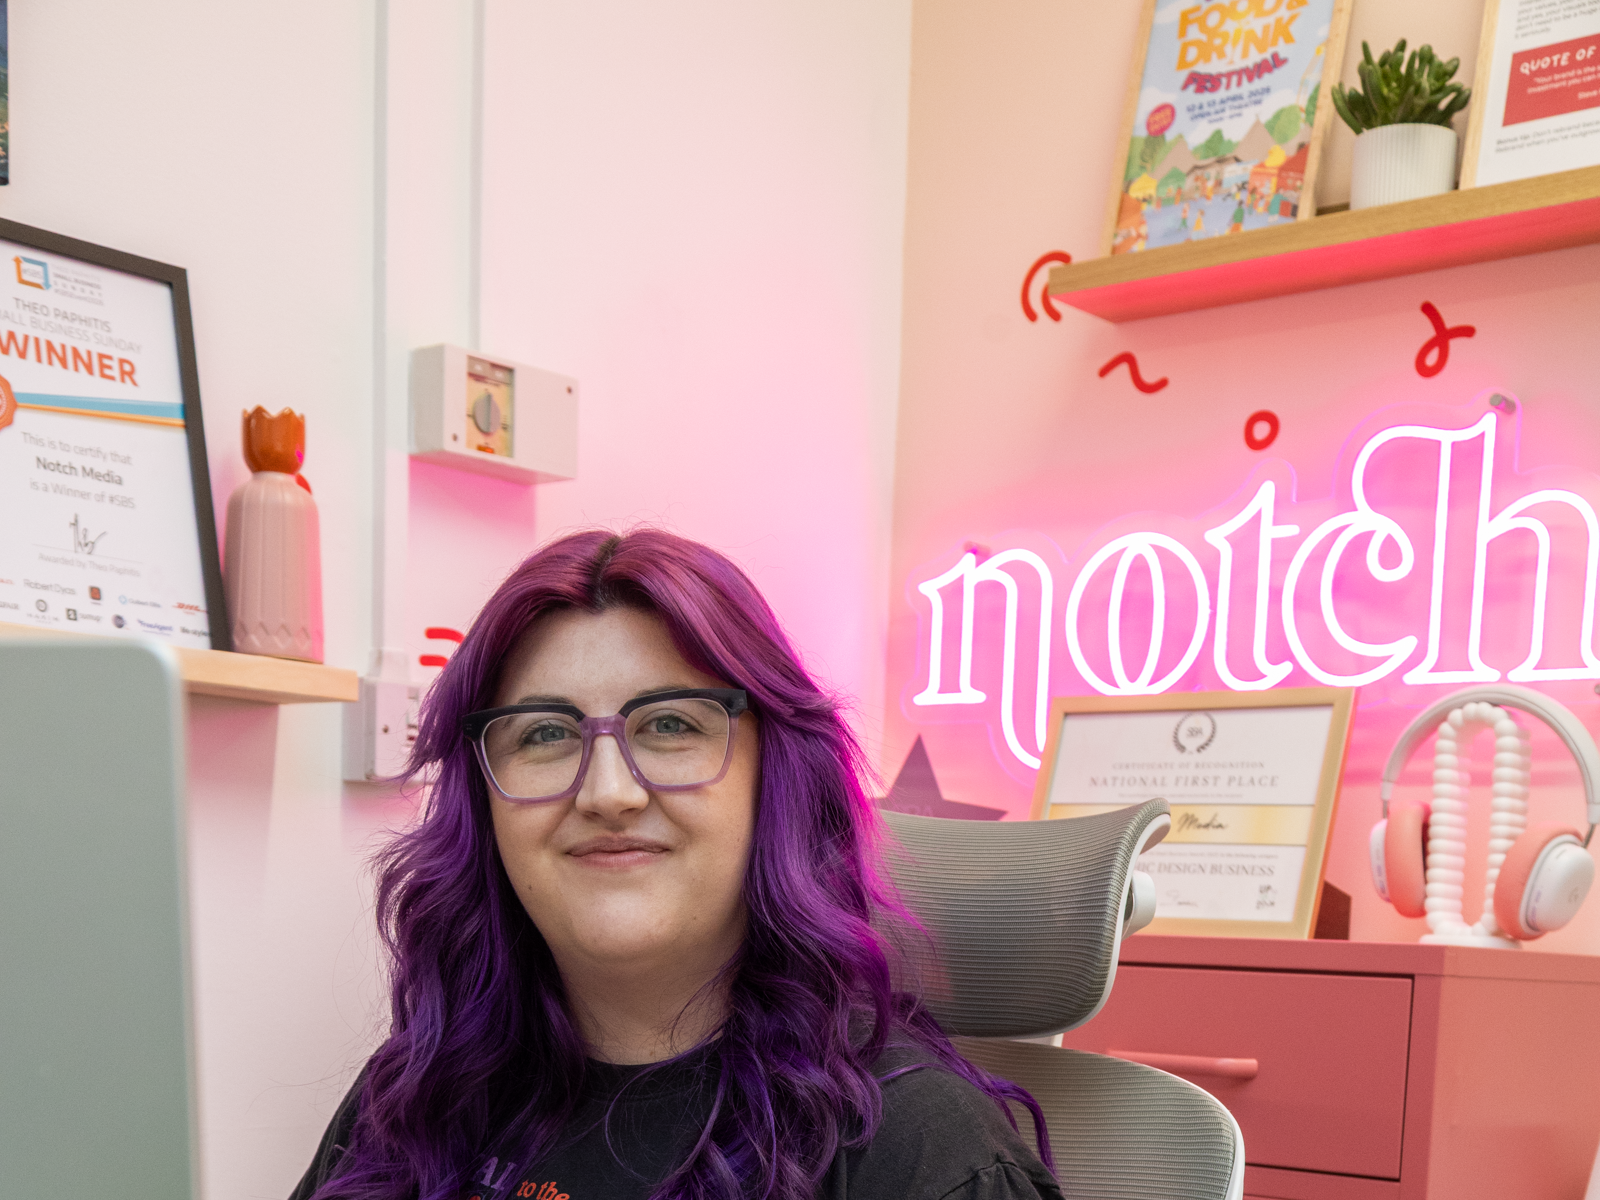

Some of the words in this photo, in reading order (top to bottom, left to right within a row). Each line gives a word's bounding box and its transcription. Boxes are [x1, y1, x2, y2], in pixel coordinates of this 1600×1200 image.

[1175, 13, 1301, 71] DRINK
[1181, 51, 1289, 94] FESTIVAL
[1519, 52, 1571, 76] QUOTE
[1575, 45, 1597, 61] OF
[0, 309, 27, 327] ALL
[30, 316, 90, 342] BUSINESS
[93, 331, 142, 353] SUNDAY
[13, 297, 49, 317] THEO
[53, 308, 112, 333] PAPHITIS
[0, 330, 139, 387] WINNER
[22, 432, 45, 448] This
[48, 437, 56, 449] is
[59, 439, 70, 451] to
[73, 443, 107, 462] certify
[110, 450, 133, 465] that
[36, 456, 78, 477] Notch
[82, 465, 123, 486] Media
[30, 478, 39, 491] is
[42, 482, 48, 492] a
[51, 482, 91, 501] Winner
[94, 491, 106, 503] of
[912, 411, 1600, 771] notch
[1112, 760, 1177, 771] CERTIFICATE
[1179, 761, 1192, 770] OF
[1194, 761, 1265, 770] RECOGNITION
[1088, 775, 1169, 789] NATIONAL
[1174, 775, 1221, 788] FIRST
[1227, 775, 1280, 788] PLACE
[1157, 862, 1207, 876] DESIGN
[1209, 863, 1275, 877] BUSINESS
[517, 1179, 537, 1198] to
